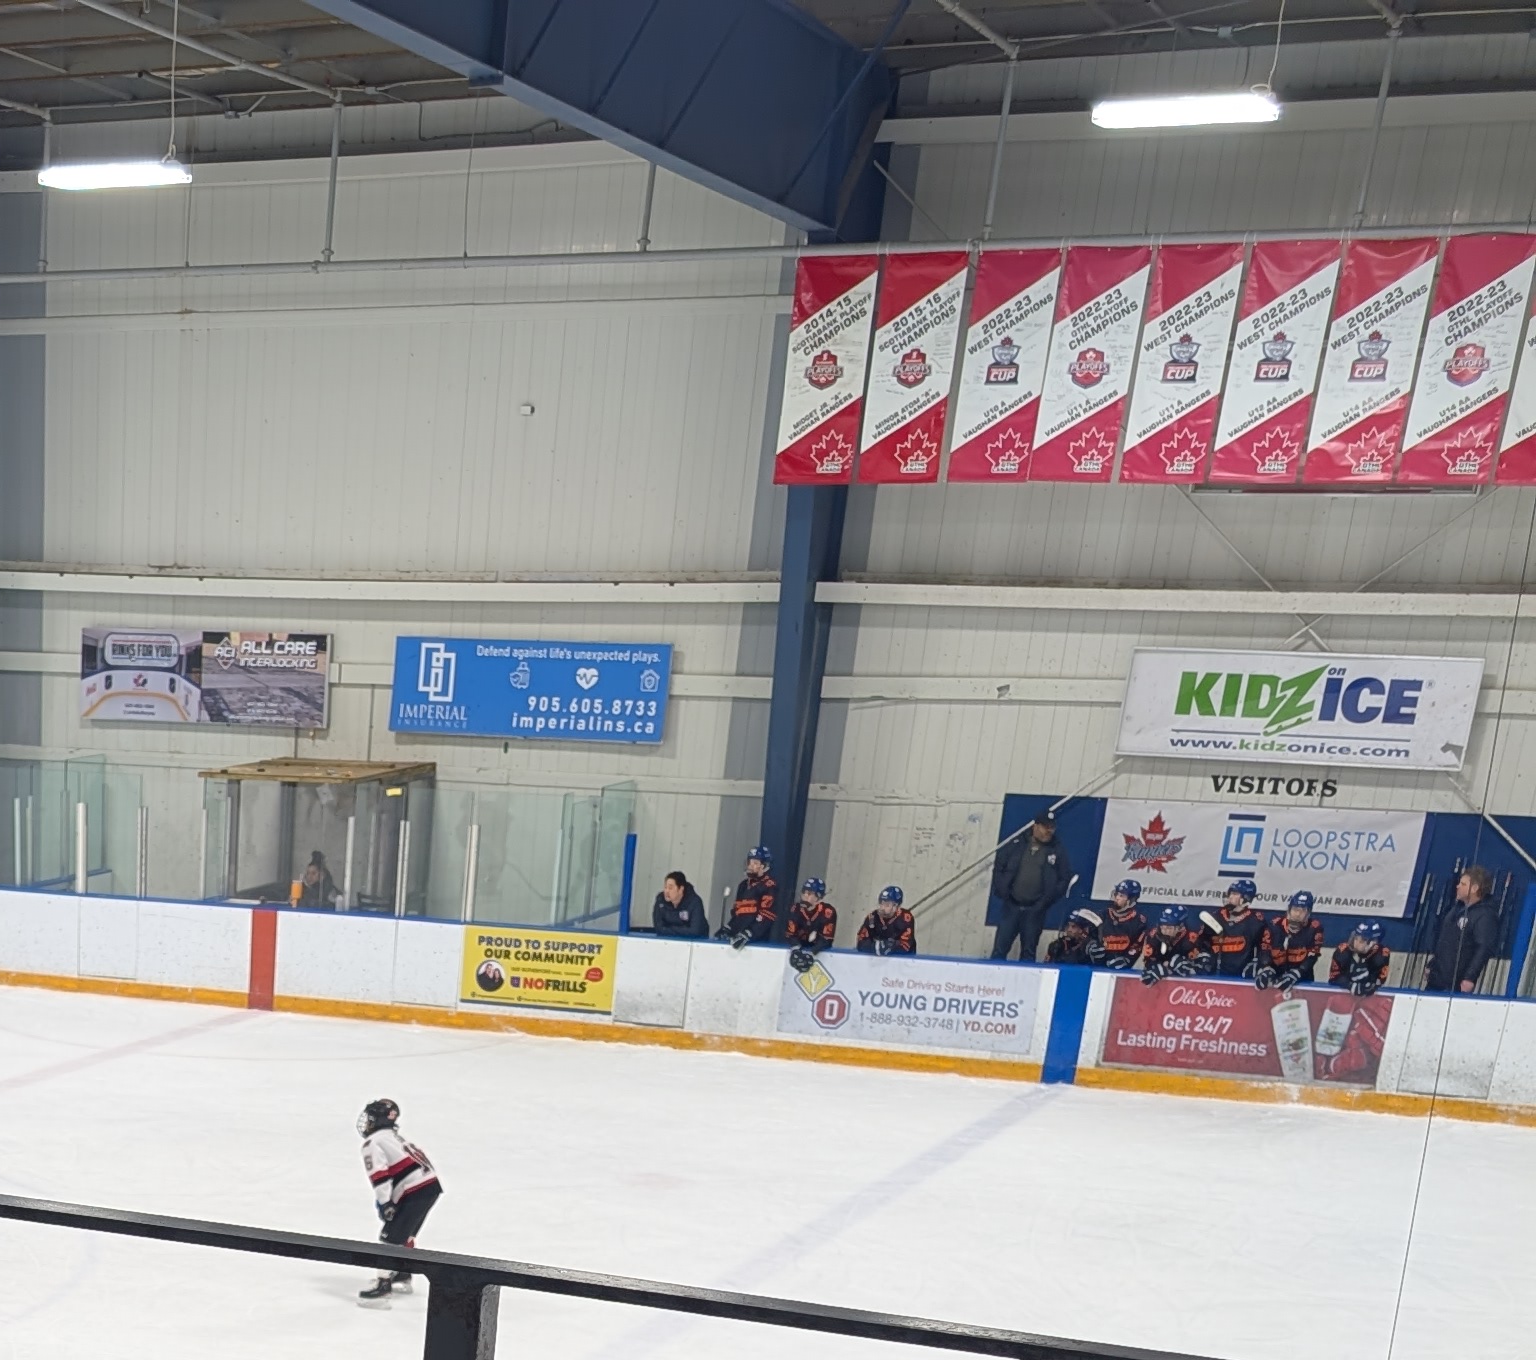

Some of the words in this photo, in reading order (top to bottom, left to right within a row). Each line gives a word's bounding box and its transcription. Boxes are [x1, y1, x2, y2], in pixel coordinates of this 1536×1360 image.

[804, 295, 852, 334] 2014-15
[892, 293, 942, 333] 2015-16
[982, 295, 1032, 334] 2022-23
[1070, 289, 1122, 328] 2022-23
[1093, 296, 1129, 323] PLAYOFF
[1144, 331, 1172, 352] WEST
[1175, 289, 1236, 334] CHAMPIONS
[1159, 291, 1213, 331] 2022-23
[1237, 329, 1265, 351] WEST
[1268, 287, 1332, 332] CHAMPIONS
[1252, 289, 1308, 329] 2022-23
[1331, 329, 1361, 350] WEST
[1363, 284, 1428, 331] CHAMPIONS
[1346, 287, 1404, 329] 2022-23
[1444, 292, 1523, 347] CHAMPIONS
[1447, 280, 1507, 322] 2022-23
[1474, 288, 1514, 317] PLAYOFF
[792, 319, 837, 354] SCOTIABANK
[839, 293, 872, 324] PLAYOFF
[803, 309, 867, 356] CHAMPIONS
[878, 317, 928, 353] SCOTIABANK
[929, 291, 961, 318] PLAYOFF
[892, 305, 957, 355] CHAMPIONS
[968, 334, 994, 355] WEST
[996, 293, 1053, 336] CHAMPIONS
[1068, 301, 1138, 350] CHAMPIONS
[990, 370, 1017, 382] CUP
[1166, 368, 1195, 380] CUP
[1259, 367, 1287, 379] CUP
[1354, 366, 1384, 378] CUP
[788, 417, 820, 440] VAUGHAN
[820, 393, 853, 421] RANGERS
[872, 413, 906, 440] VAUGHAN
[907, 392, 941, 418] RANGERS
[962, 414, 997, 438] VAUGHAN
[999, 391, 1033, 417] RANGERS
[1044, 412, 1081, 437] VAUGHAN
[1082, 390, 1118, 414] RANGERS
[1136, 413, 1173, 438] VAUGHAN
[1175, 389, 1211, 415] RANGERS
[1227, 413, 1265, 438] VAUGHAN
[1267, 388, 1304, 414] RANGERS
[1321, 412, 1360, 439] VAUGHAN
[1363, 388, 1401, 415] RANGERS
[1416, 412, 1456, 438] VAUGHAN
[1458, 387, 1499, 414] RANGERS
[239, 657, 316, 669] INTERLOCKING
[240, 640, 272, 655] ALL
[274, 641, 317, 656] CARE
[476, 645, 510, 658] Defend
[512, 646, 548, 661] against
[549, 647, 571, 660] life's
[574, 649, 630, 664] unexpected
[632, 650, 661, 665] plays.
[1328, 665, 1347, 677] on
[399, 703, 468, 720] IMPERIAL
[527, 696, 657, 717] 905.605.8733
[1174, 663, 1331, 736] KIDZ
[1318, 677, 1424, 725] ICE
[512, 713, 655, 734] imperialins.ca
[1169, 736, 1410, 758] www.kidzonice.com
[1272, 828, 1396, 853] LOOPSTRA
[1268, 851, 1350, 872] NIXON
[1355, 864, 1373, 873] LLP
[1142, 887, 1178, 896] FFICIAL
[1182, 889, 1204, 897] LAW
[1256, 893, 1278, 901] OUR
[1334, 898, 1385, 909] RANGERS
[478, 935, 521, 949] PROUD
[525, 939, 540, 950] TO
[544, 941, 603, 955] SUPPORT
[484, 948, 511, 960] OUR
[514, 950, 595, 966] COMMUNITY
[858, 990, 927, 1011] YOUNG
[933, 996, 1019, 1019] DRIVERS
[881, 977, 904, 989] Safe
[907, 980, 942, 994] Driving
[944, 982, 974, 995] Starts
[977, 985, 1005, 998] Here!
[1169, 986, 1201, 1006] Old
[1199, 988, 1234, 1009] Spice
[824, 1000, 839, 1020] D
[859, 1011, 953, 1030] 1-888-932-3748
[963, 1021, 1016, 1035] YD.COM
[1162, 1013, 1191, 1031] Get
[1193, 1015, 1233, 1035] 24/7
[1117, 1030, 1176, 1053] Lasting
[1179, 1034, 1267, 1056] Freshness
